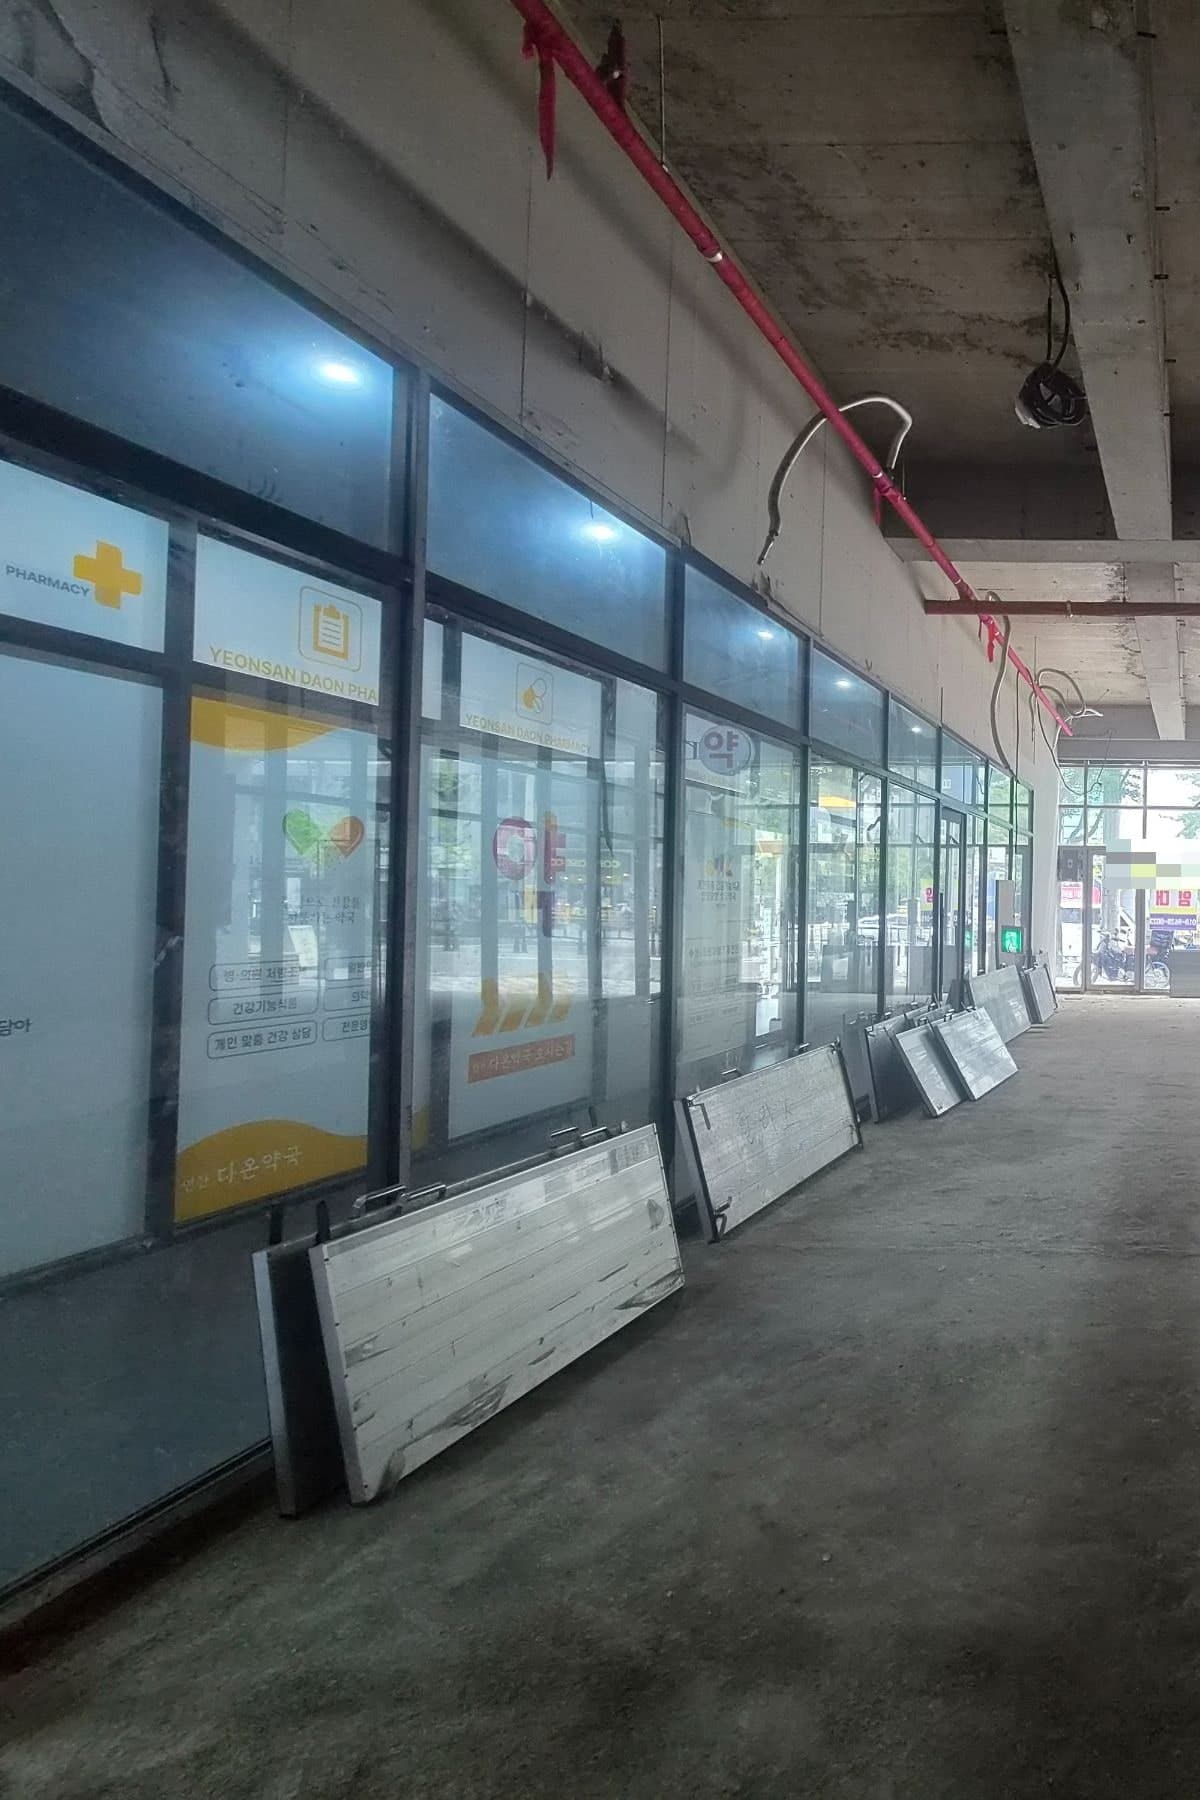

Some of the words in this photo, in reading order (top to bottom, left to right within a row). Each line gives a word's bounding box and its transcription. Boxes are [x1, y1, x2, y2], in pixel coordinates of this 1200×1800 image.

[6, 564, 91, 598] PHARMACY
[209, 645, 297, 683] YEONSAN
[300, 670, 345, 694] DAON
[465, 712, 515, 737] YEONSAN
[517, 727, 544, 744] DAON
[545, 733, 592, 754] PHARMACY
[703, 730, 740, 769] 약
[266, 1030, 289, 1044] 건강
[291, 1026, 312, 1041] 상담
[216, 1143, 305, 1185] 다온약국
